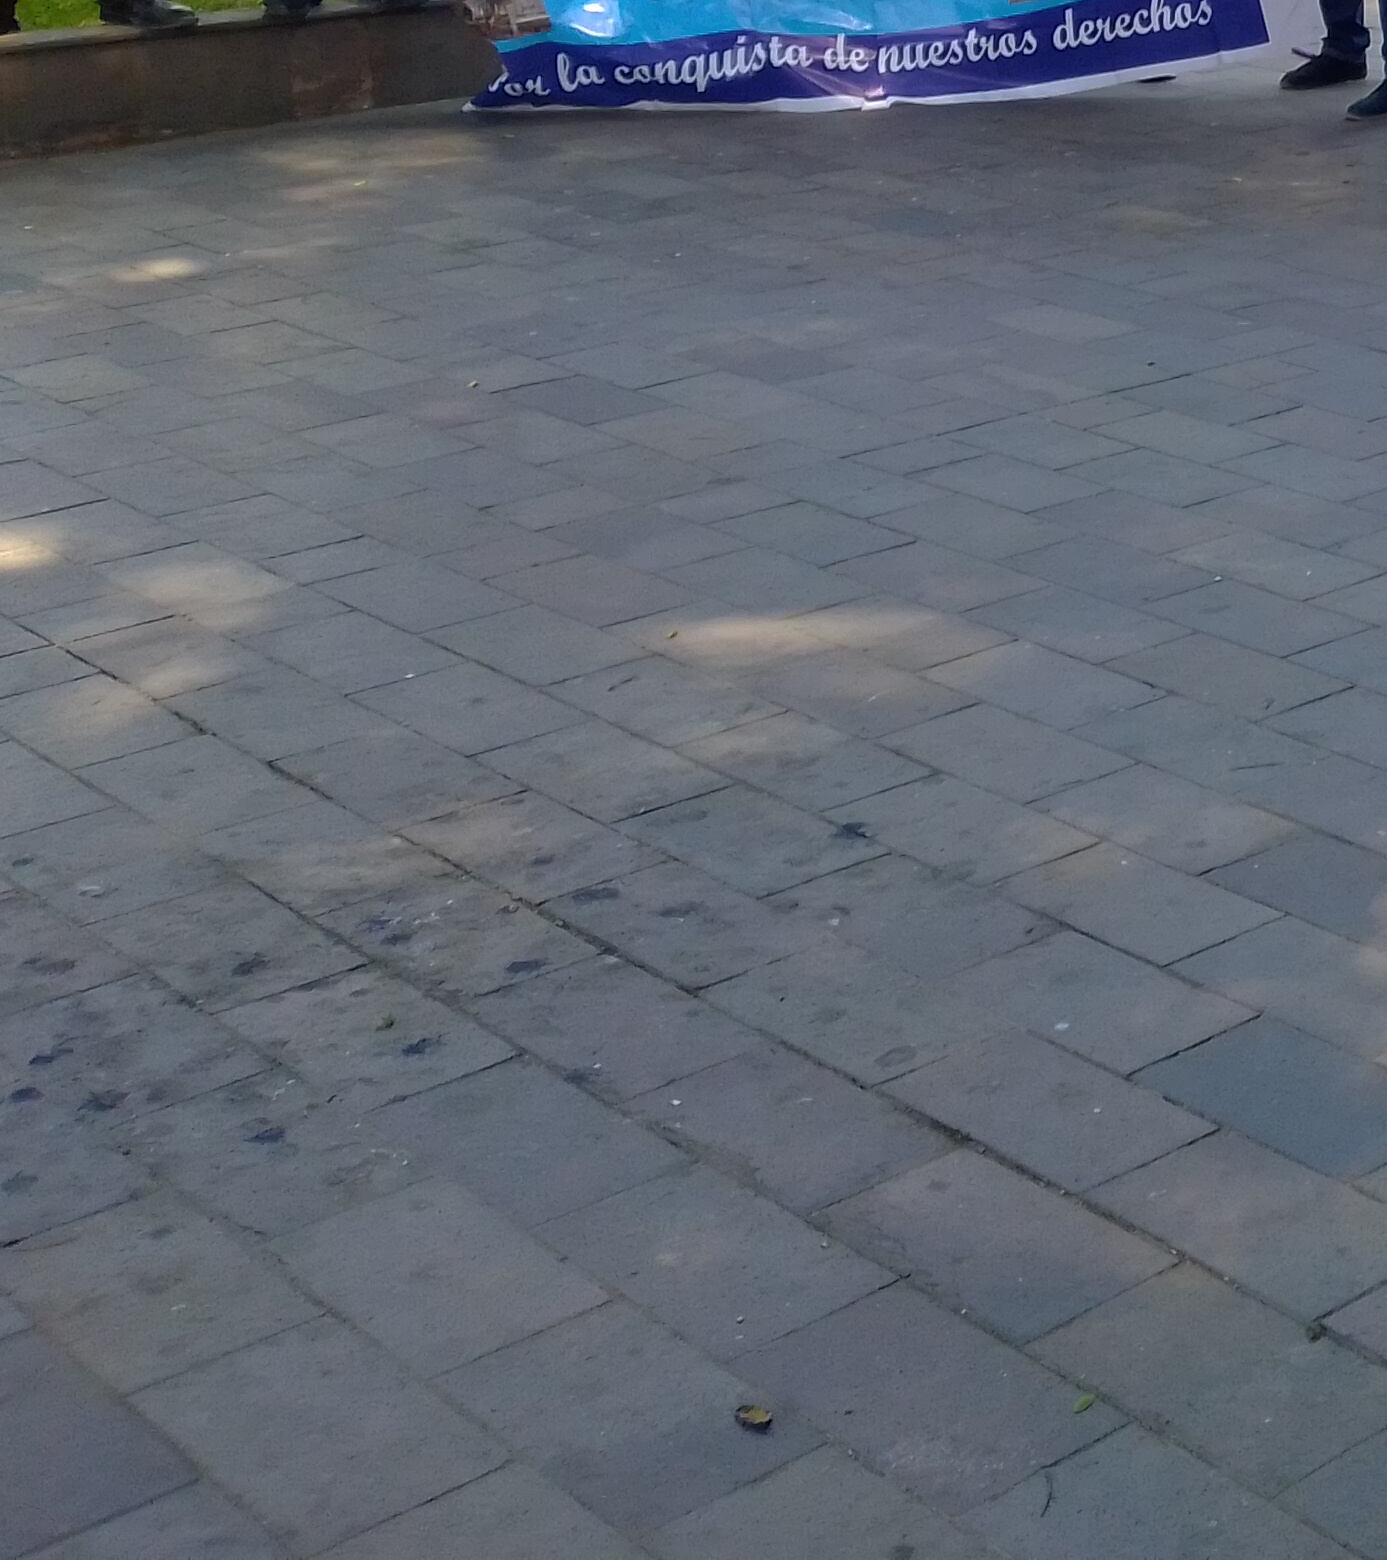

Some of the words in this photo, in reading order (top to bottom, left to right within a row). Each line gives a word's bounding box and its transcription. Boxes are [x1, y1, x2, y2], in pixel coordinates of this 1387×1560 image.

[556, 52, 606, 92] la
[614, 34, 813, 93] conquista
[823, 33, 870, 73] de
[878, 28, 1036, 74] nuestros
